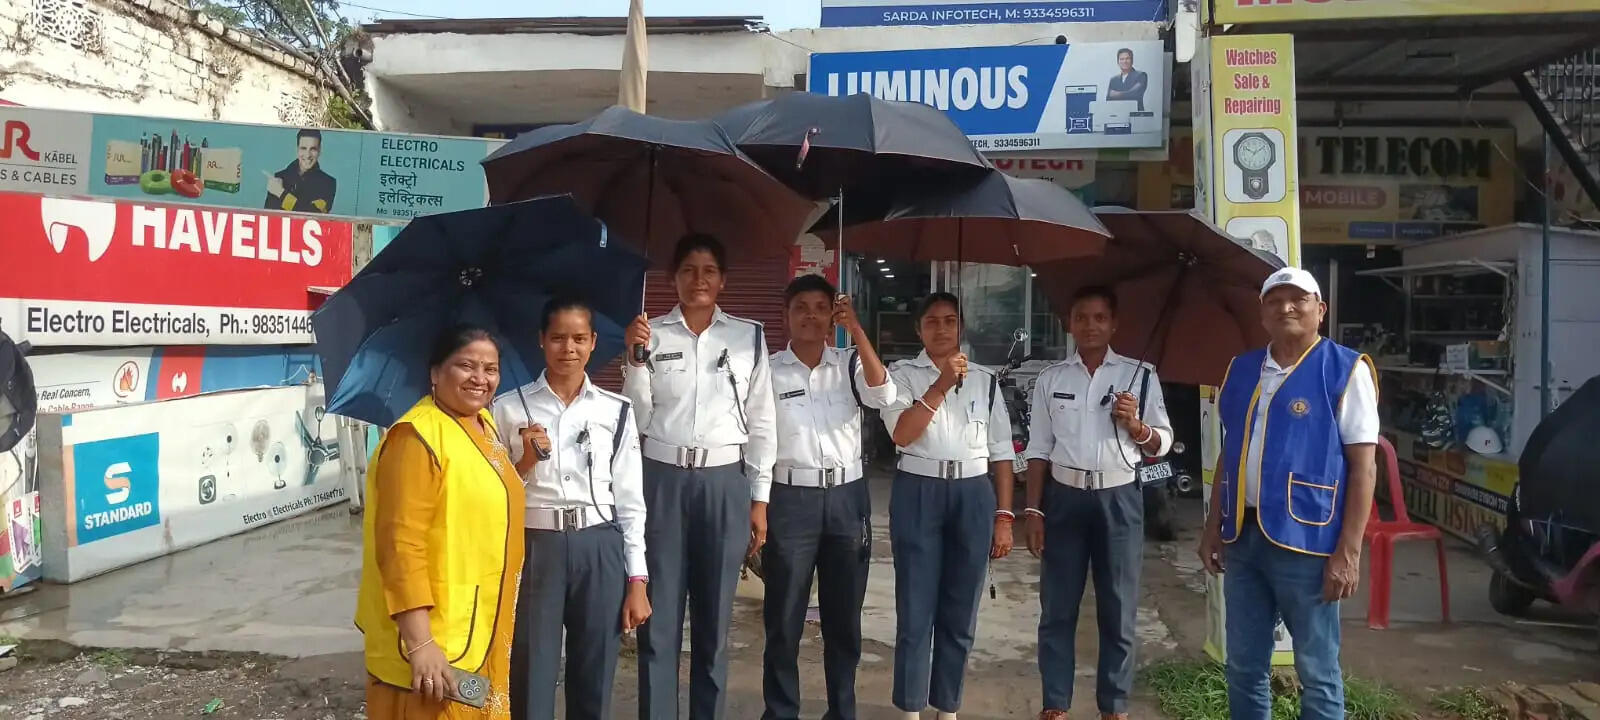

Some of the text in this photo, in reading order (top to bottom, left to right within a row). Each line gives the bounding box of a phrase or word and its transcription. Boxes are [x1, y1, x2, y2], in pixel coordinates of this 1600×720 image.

[883, 7, 1095, 22] SARDA INFOTECH, M: 9334596311
[1225, 48, 1277, 66] Watches
[828, 65, 1029, 111] LUMINOUS
[1234, 73, 1271, 89] Sale &
[1224, 97, 1281, 115] Repairing
[382, 138, 438, 152] ELECTRO
[994, 138, 1040, 148] 9334596311
[380, 155, 465, 171] ELECTRICALS
[1316, 136, 1491, 178] TELECOM
[11, 170, 20, 181] &
[23, 171, 77, 185] CABLES
[380, 170, 417, 189] इलेक्ट्रो
[1305, 189, 1378, 205] MOBILE
[132, 205, 323, 266] HAVELLS
[27, 307, 105, 333] Electro
[112, 309, 210, 336] Electricals,
[220, 313, 248, 333] Ph.:
[41, 388, 91, 401] Real Concern,
[84, 501, 152, 530] STANDARD
[243, 511, 267, 525] Electro
[272, 499, 304, 516] Electricals
